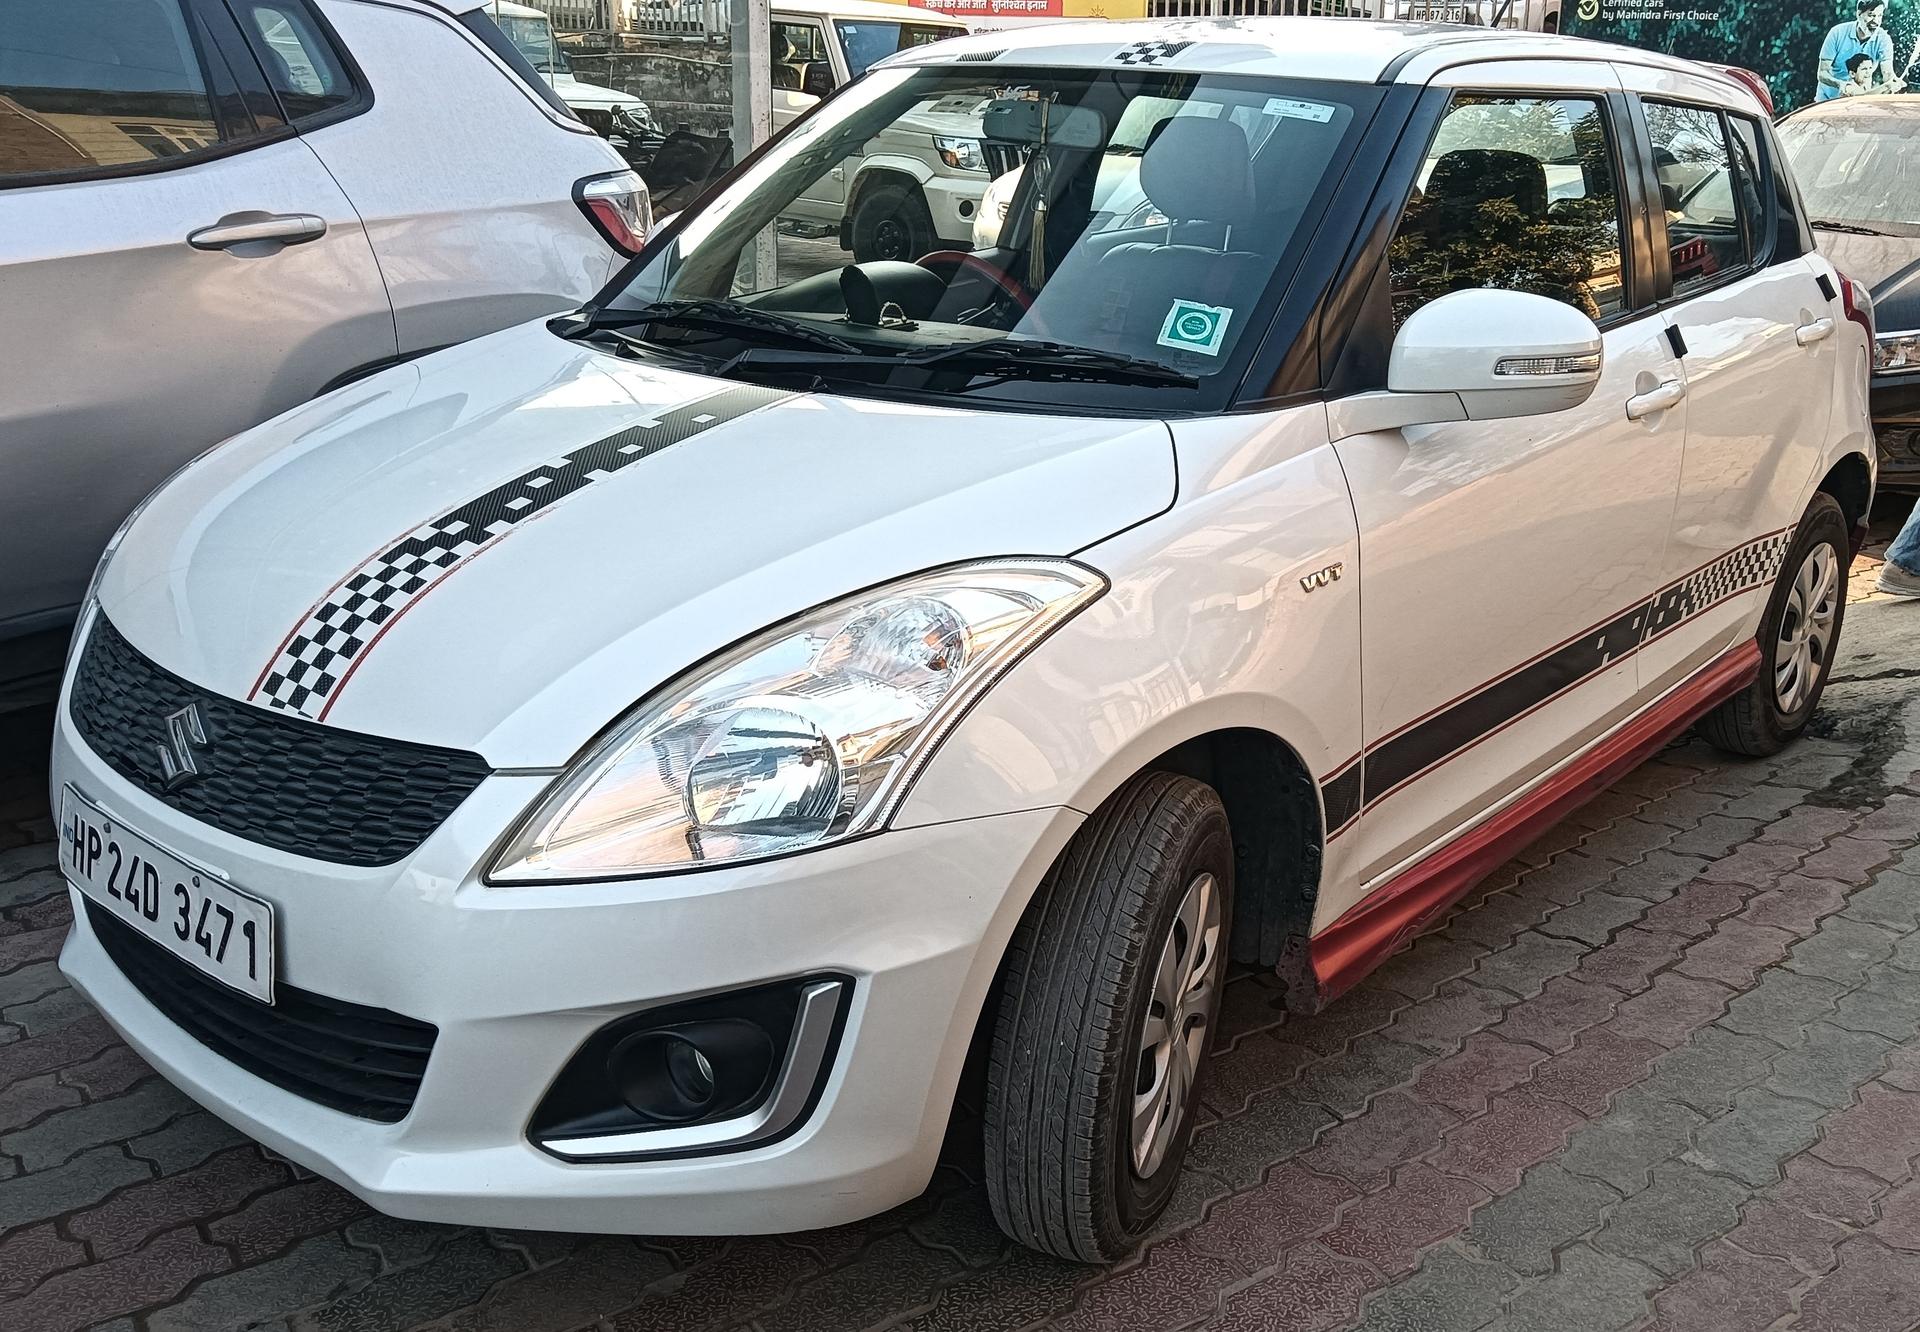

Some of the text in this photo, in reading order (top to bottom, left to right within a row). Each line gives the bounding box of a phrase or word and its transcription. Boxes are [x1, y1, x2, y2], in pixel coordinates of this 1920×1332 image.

[1602, 9, 1719, 21] by Mahindra First Choice
[72, 814, 256, 981] HP 24D 3471
